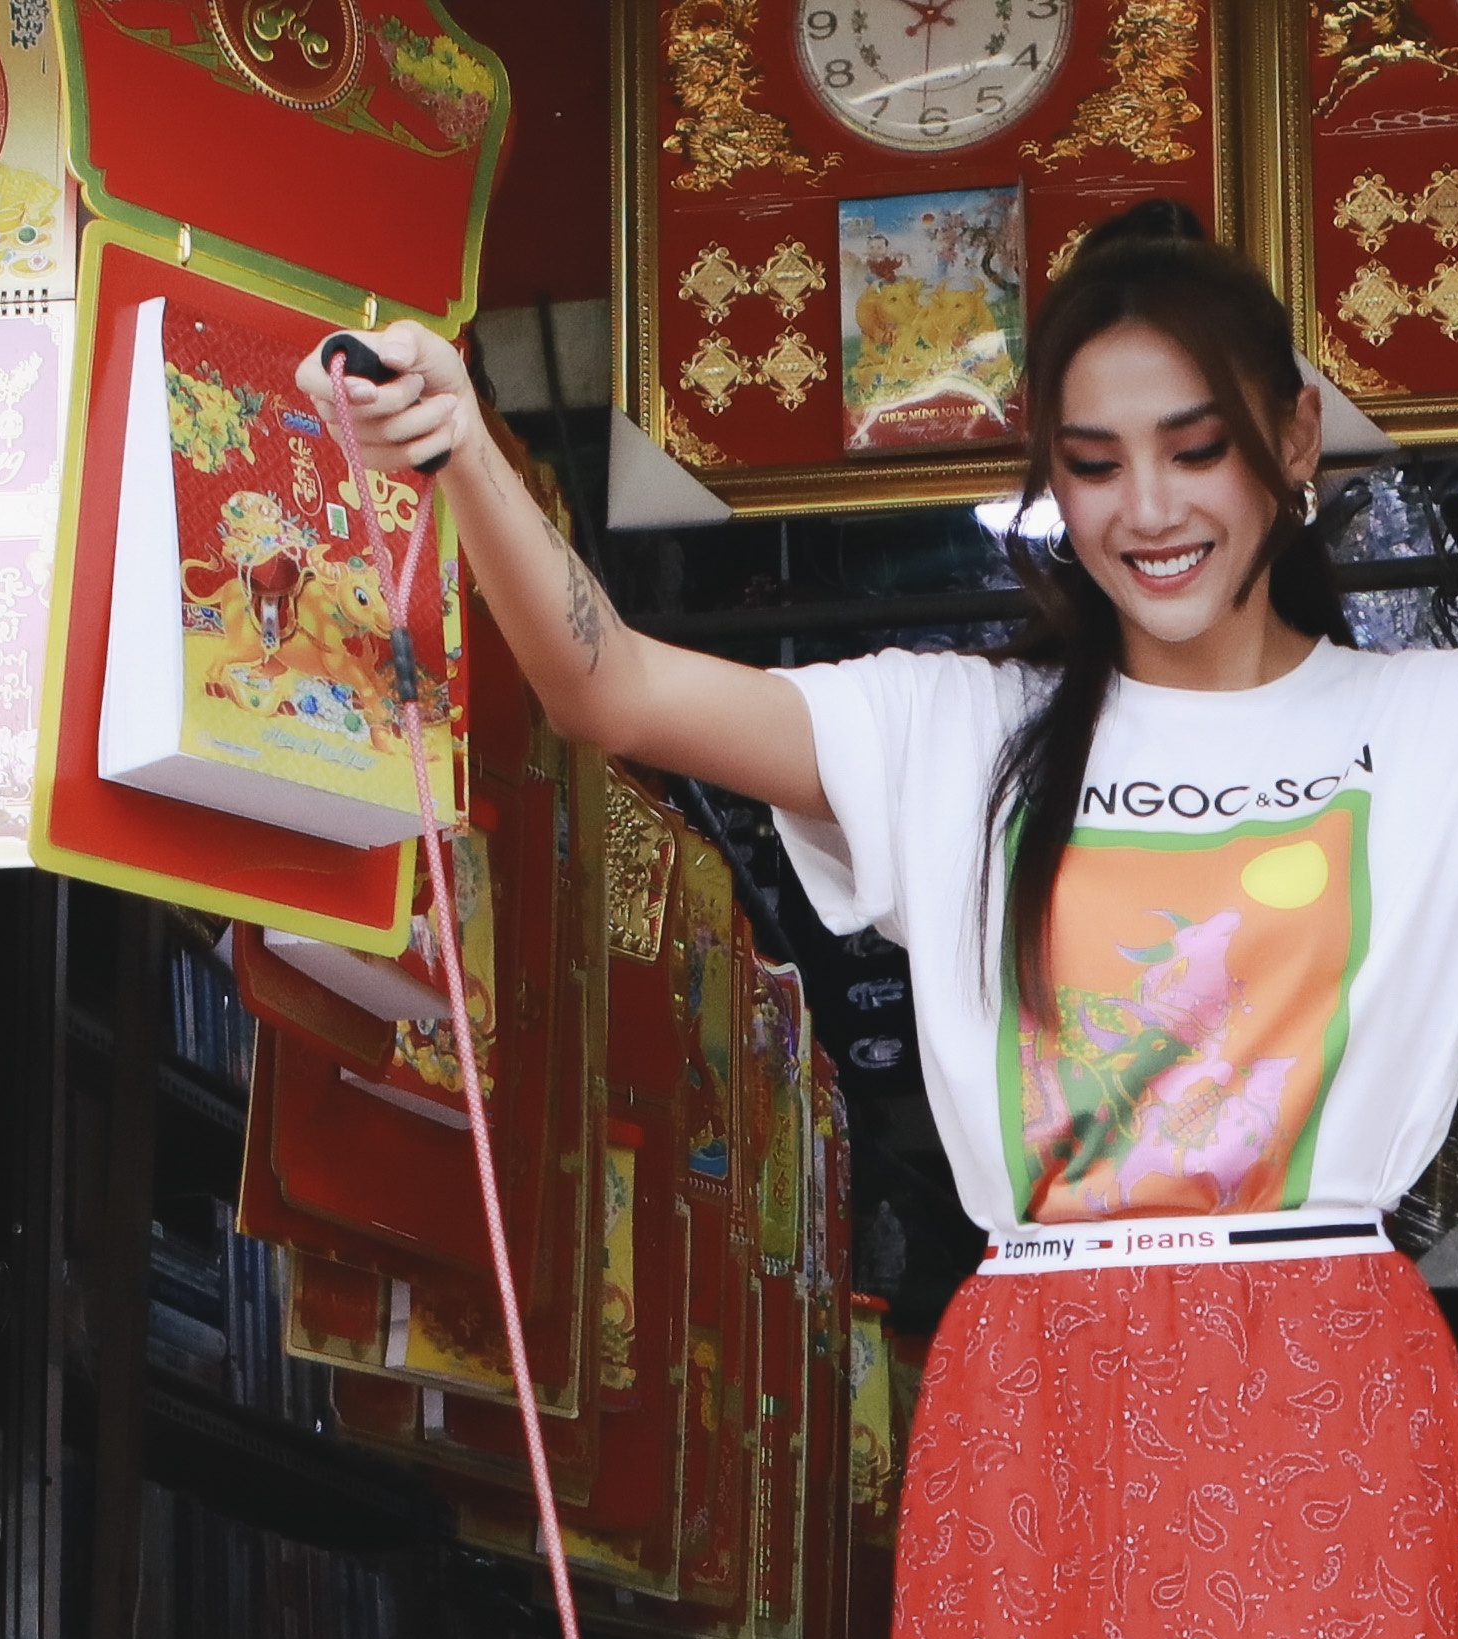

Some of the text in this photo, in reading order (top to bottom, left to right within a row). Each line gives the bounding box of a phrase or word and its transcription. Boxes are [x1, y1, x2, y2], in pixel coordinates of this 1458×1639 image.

[807, 10, 837, 39] 9
[1011, 42, 1040, 71] 4
[825, 59, 855, 88] 8
[976, 86, 1007, 115] 5
[918, 106, 950, 136] 6
[1003, 1227, 1216, 1260] tommy jeans
